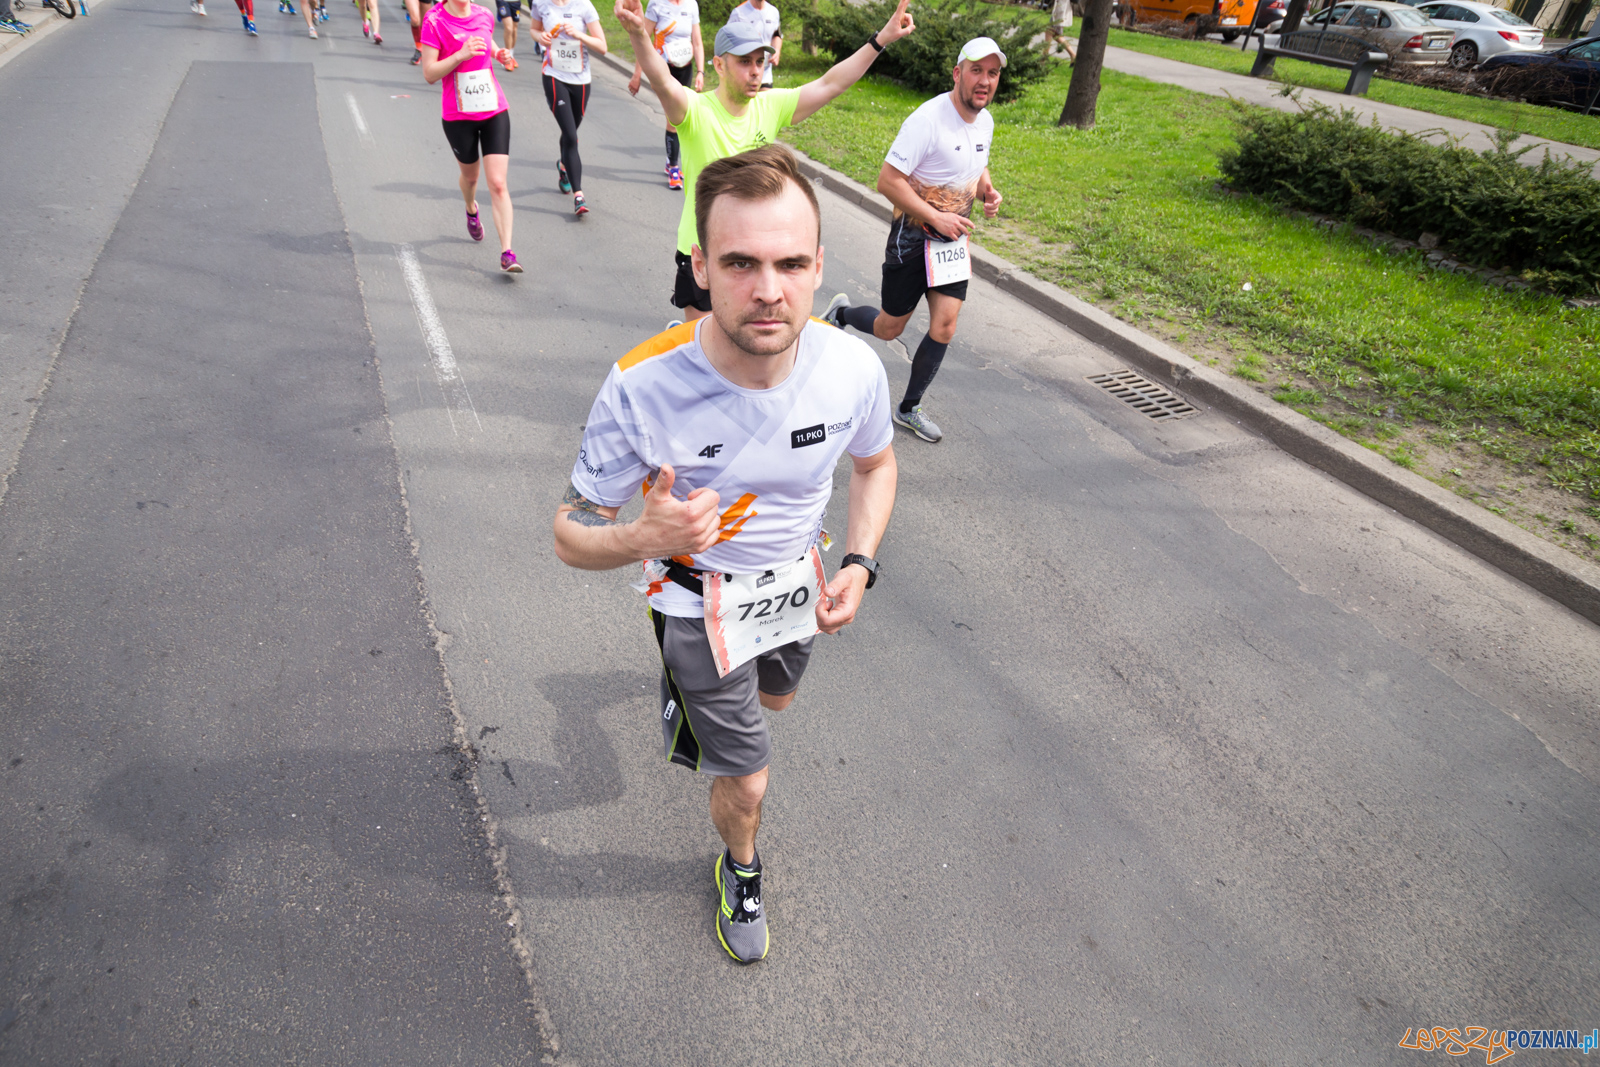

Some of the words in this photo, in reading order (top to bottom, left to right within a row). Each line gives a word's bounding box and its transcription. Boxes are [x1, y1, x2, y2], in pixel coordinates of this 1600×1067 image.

[556, 49, 577, 59] 1845
[670, 47, 692, 58] 10082
[465, 83, 491, 95] 4493
[935, 247, 966, 264] 11268
[807, 429, 823, 441] PKO
[698, 443, 723, 458] 4F
[737, 585, 810, 622] 7270
[759, 615, 784, 627] Marek
